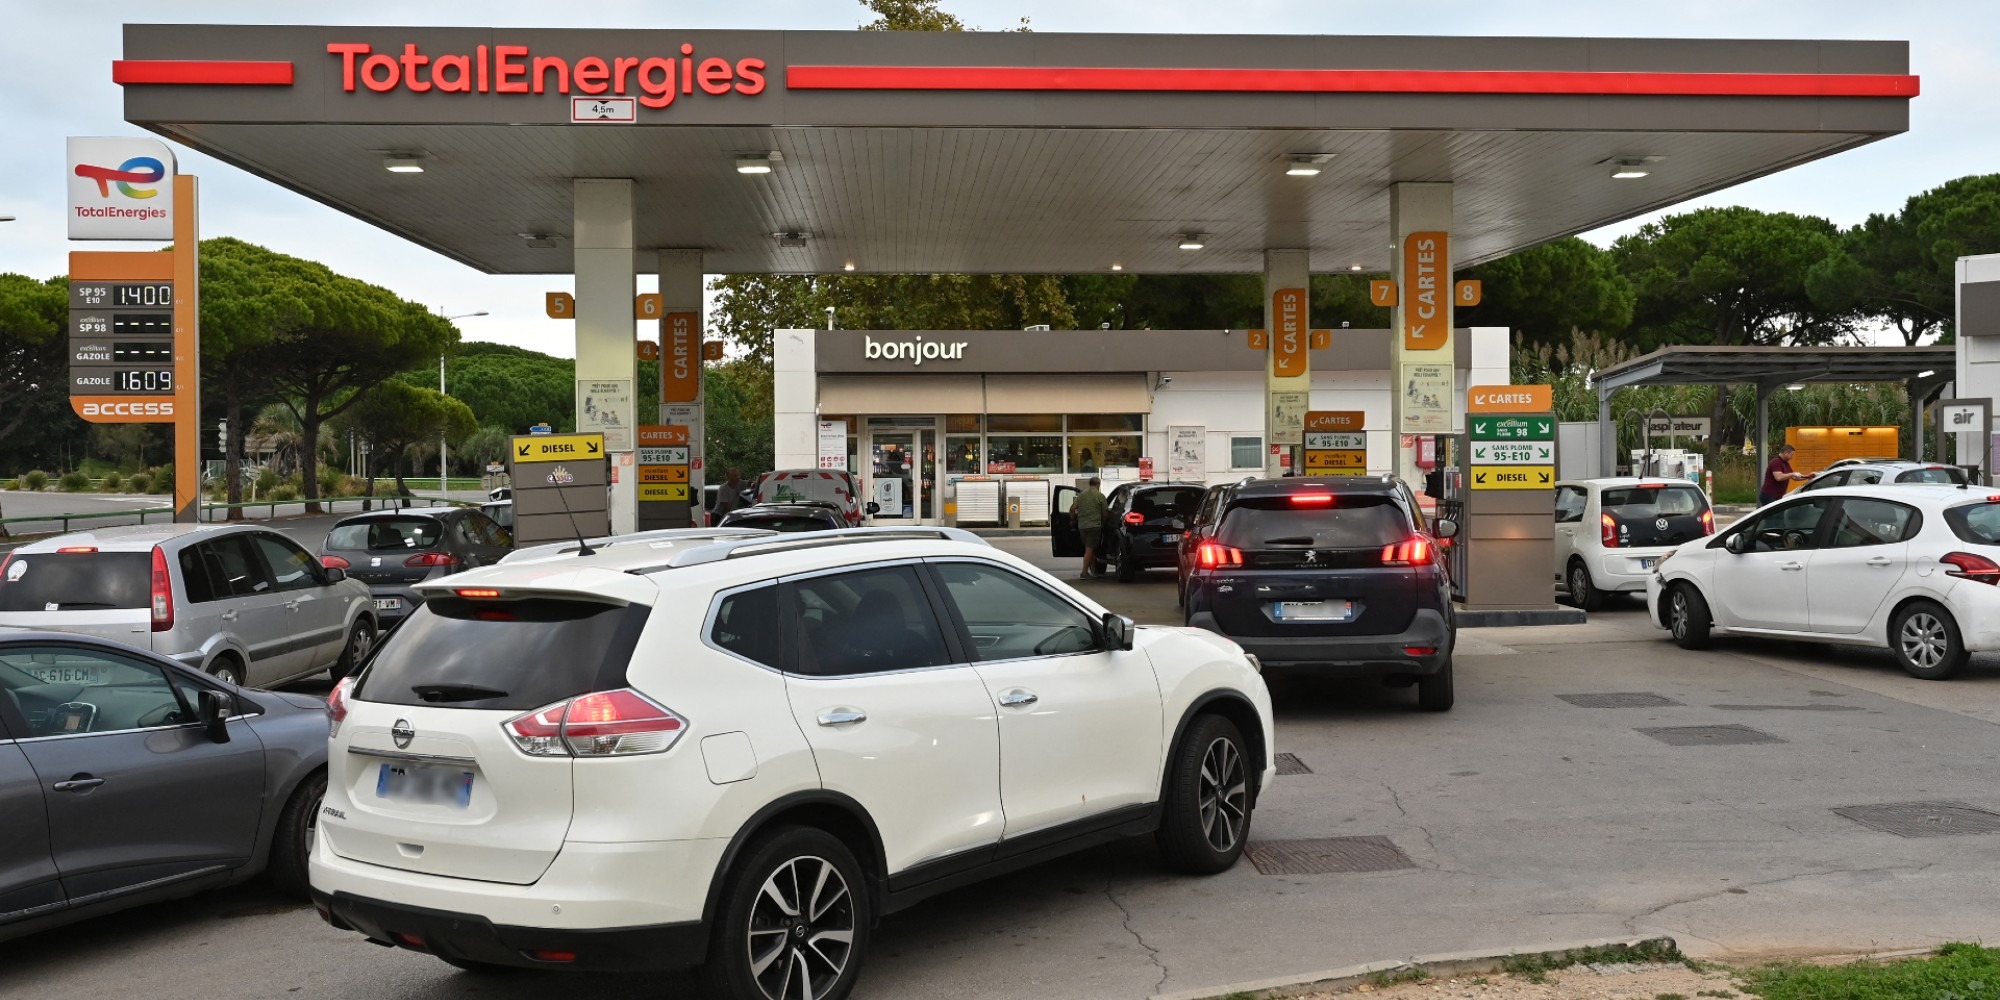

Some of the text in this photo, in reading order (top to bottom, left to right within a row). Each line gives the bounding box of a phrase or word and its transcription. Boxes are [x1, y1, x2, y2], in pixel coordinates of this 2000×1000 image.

[327, 43, 766, 108] TotalEnergies
[592, 104, 615, 115] 4,5m
[75, 206, 166, 220] TotalEnergies
[1418, 239, 1436, 319] CARTES
[79, 287, 106, 296] SP 95
[1379, 285, 1389, 301] 7
[1463, 285, 1473, 301] 8
[554, 297, 565, 313] 5
[644, 298, 655, 314] 6
[79, 323, 107, 332] SP 98
[1283, 294, 1297, 354] CARTES
[1253, 334, 1261, 346] 2
[1318, 334, 1323, 346] 1
[643, 345, 652, 356] 4
[674, 318, 688, 378] CARTES
[710, 345, 718, 356] 3
[865, 335, 968, 365] bonjour
[122, 371, 172, 391] 1.609
[1489, 393, 1532, 404] CARTES
[83, 403, 174, 415] access
[1319, 416, 1351, 425] CARTES
[1953, 408, 1975, 424] air
[1516, 428, 1528, 437] 98
[1651, 421, 1703, 433] aspirateur
[641, 431, 673, 439] CARTES
[541, 444, 576, 454] DIESEL
[1494, 452, 1530, 461] 95-E10
[1496, 473, 1528, 482] DIESEL
